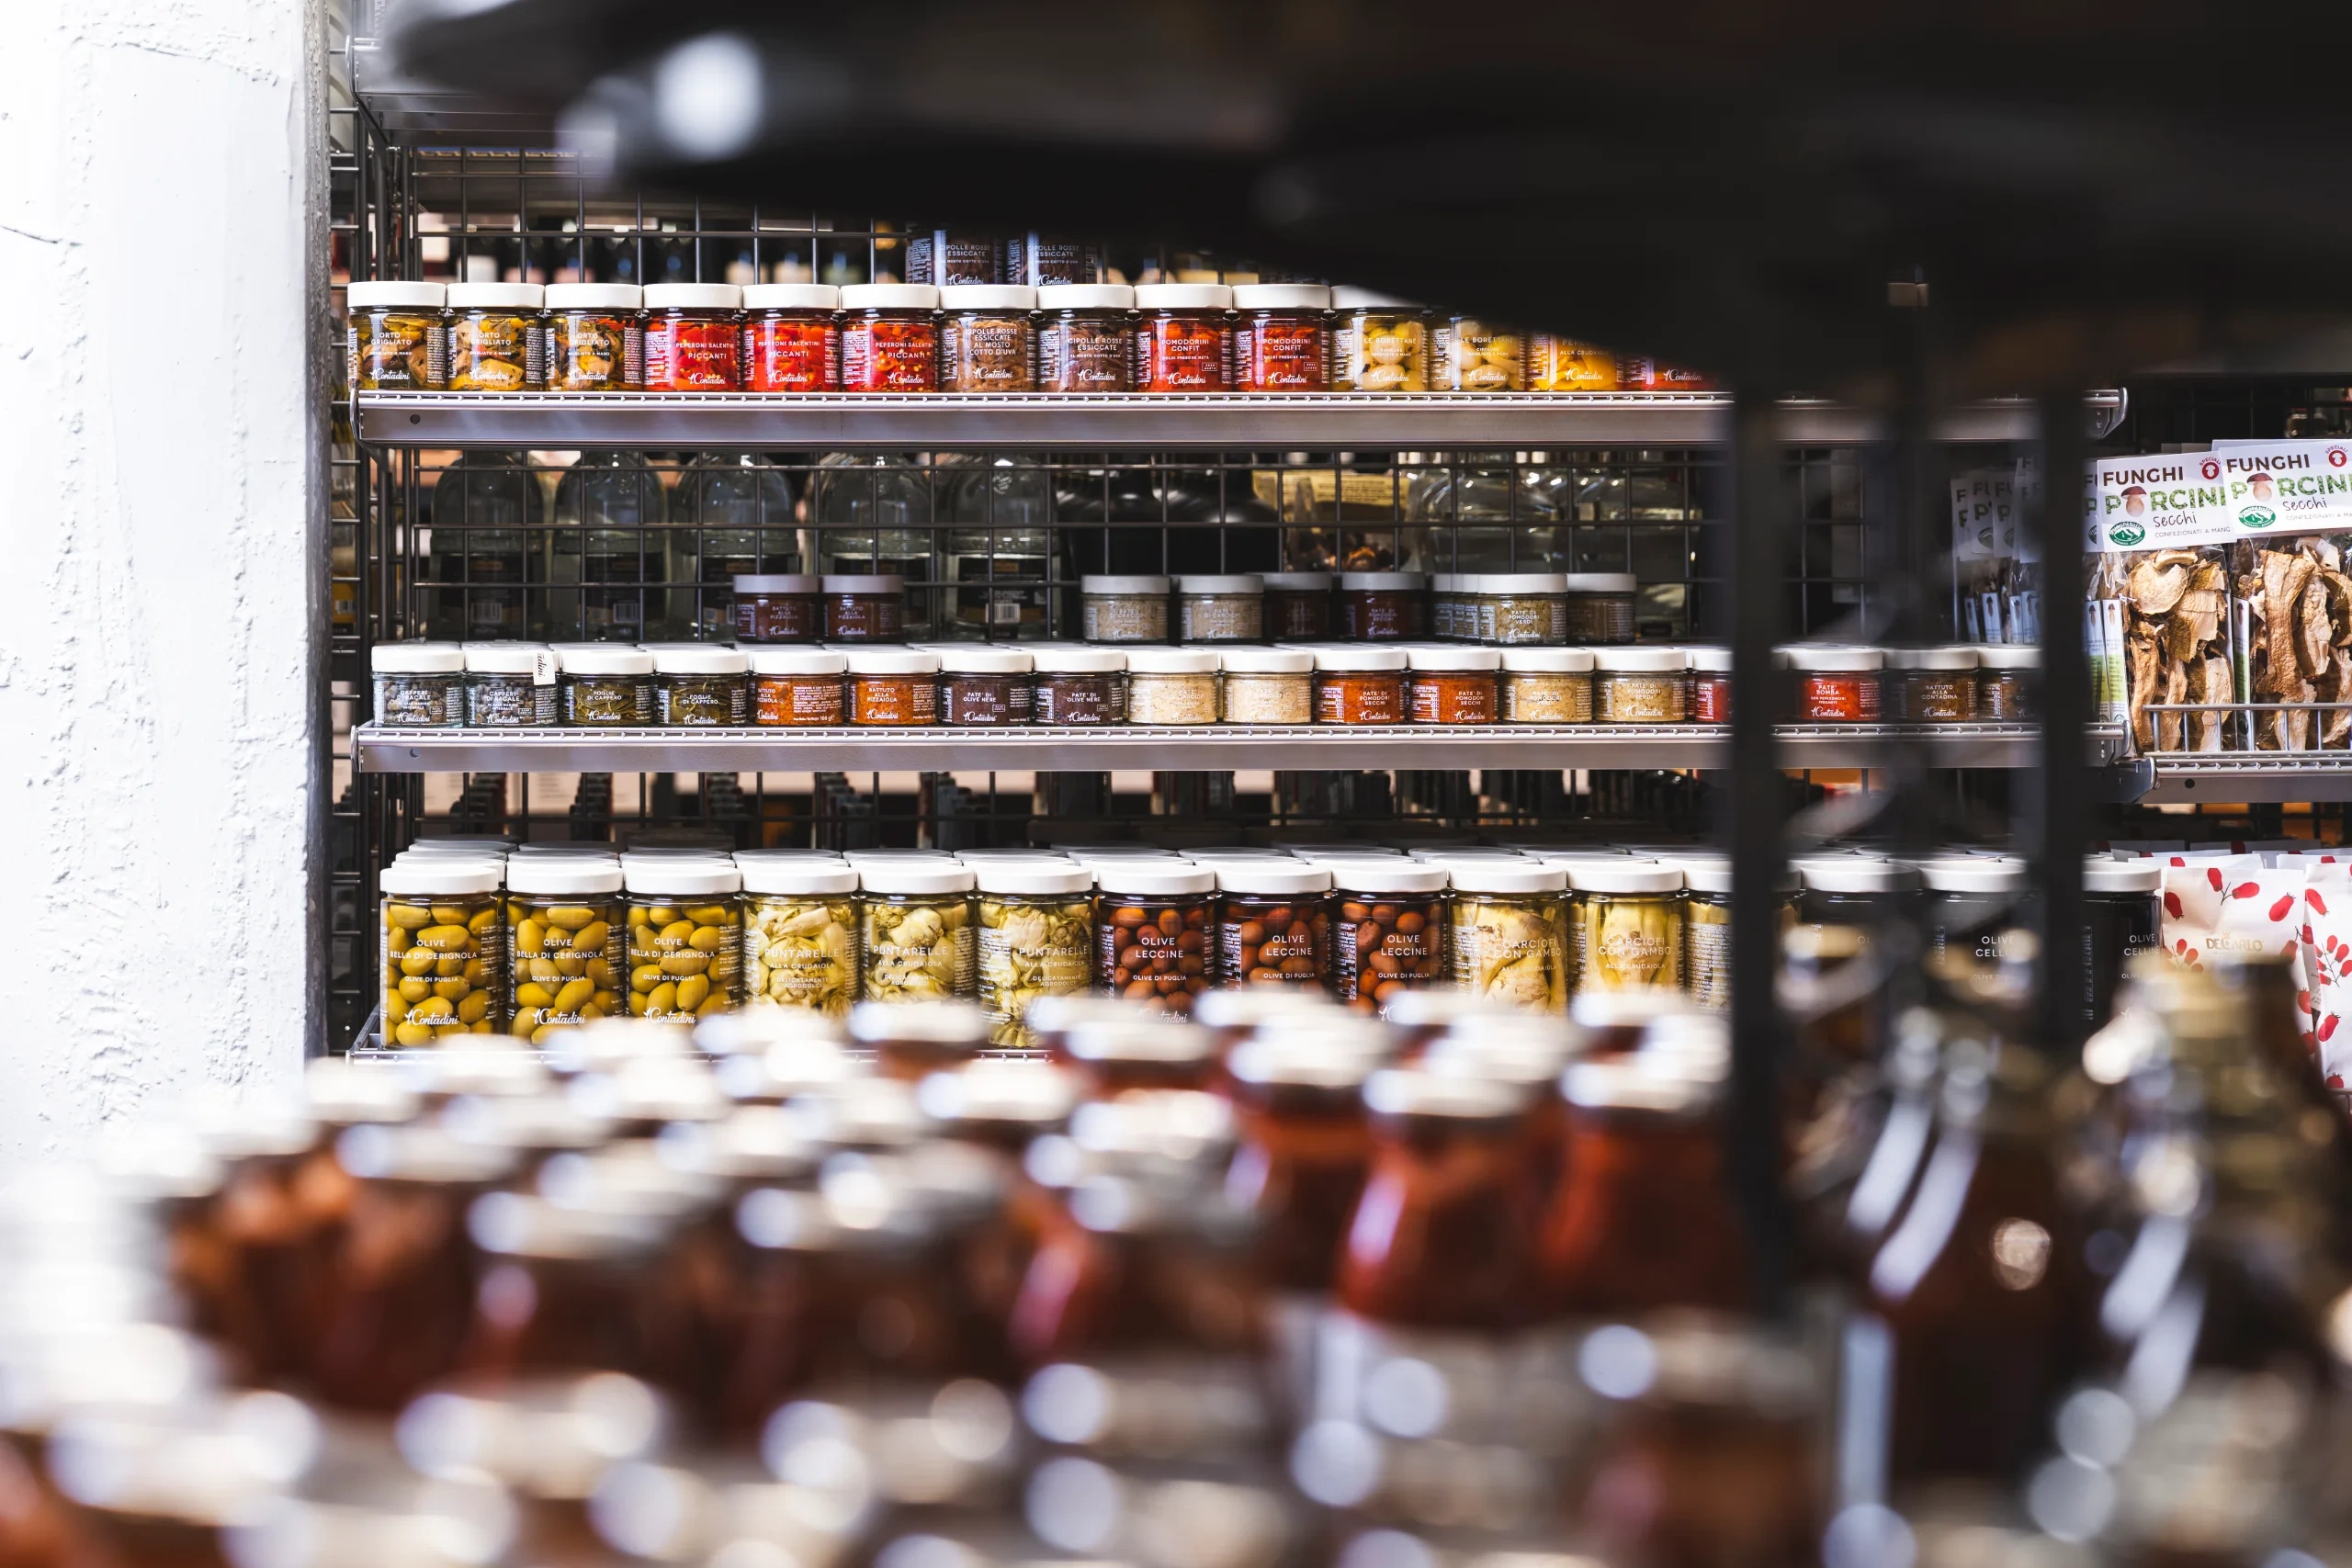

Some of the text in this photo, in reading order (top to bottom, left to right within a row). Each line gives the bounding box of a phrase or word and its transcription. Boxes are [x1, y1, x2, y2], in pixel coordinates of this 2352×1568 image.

[2226, 455, 2310, 472] FUNGHI
[2103, 467, 2183, 486] FUNGHI
[2283, 498, 2327, 511] secchi
[2153, 511, 2196, 527] secchi
[654, 938, 682, 946] OLIVE
[1142, 937, 1174, 945] OLIVE
[1272, 935, 1305, 943] OLIVE
[1387, 934, 1419, 943] OLIVE
[1607, 937, 1665, 946] CARCIOFI
[1981, 935, 2014, 944] OLIVE
[2130, 933, 2155, 942] OLIVE
[417, 939, 445, 947] OLIVE
[1503, 939, 1556, 949] CARCIOFI
[517, 950, 538, 958] BELLA
[554, 951, 603, 959] CERIGNOLA
[631, 949, 649, 957] BELLA
[764, 949, 839, 958] PUNTARELLE
[874, 945, 947, 955] PUNTARELLE
[1019, 945, 1087, 956] PUNTARELLE
[1136, 950, 1183, 958] LECCINE
[1267, 947, 1312, 956] LECCINE
[1381, 947, 1427, 956] LECCINE
[1494, 948, 1561, 959] CON GAMBO
[1599, 946, 1671, 955] CON GAMBO
[2124, 946, 2159, 955] CELLINE
[390, 951, 412, 959] BELLA
[426, 952, 477, 960] CERIGNOLA
